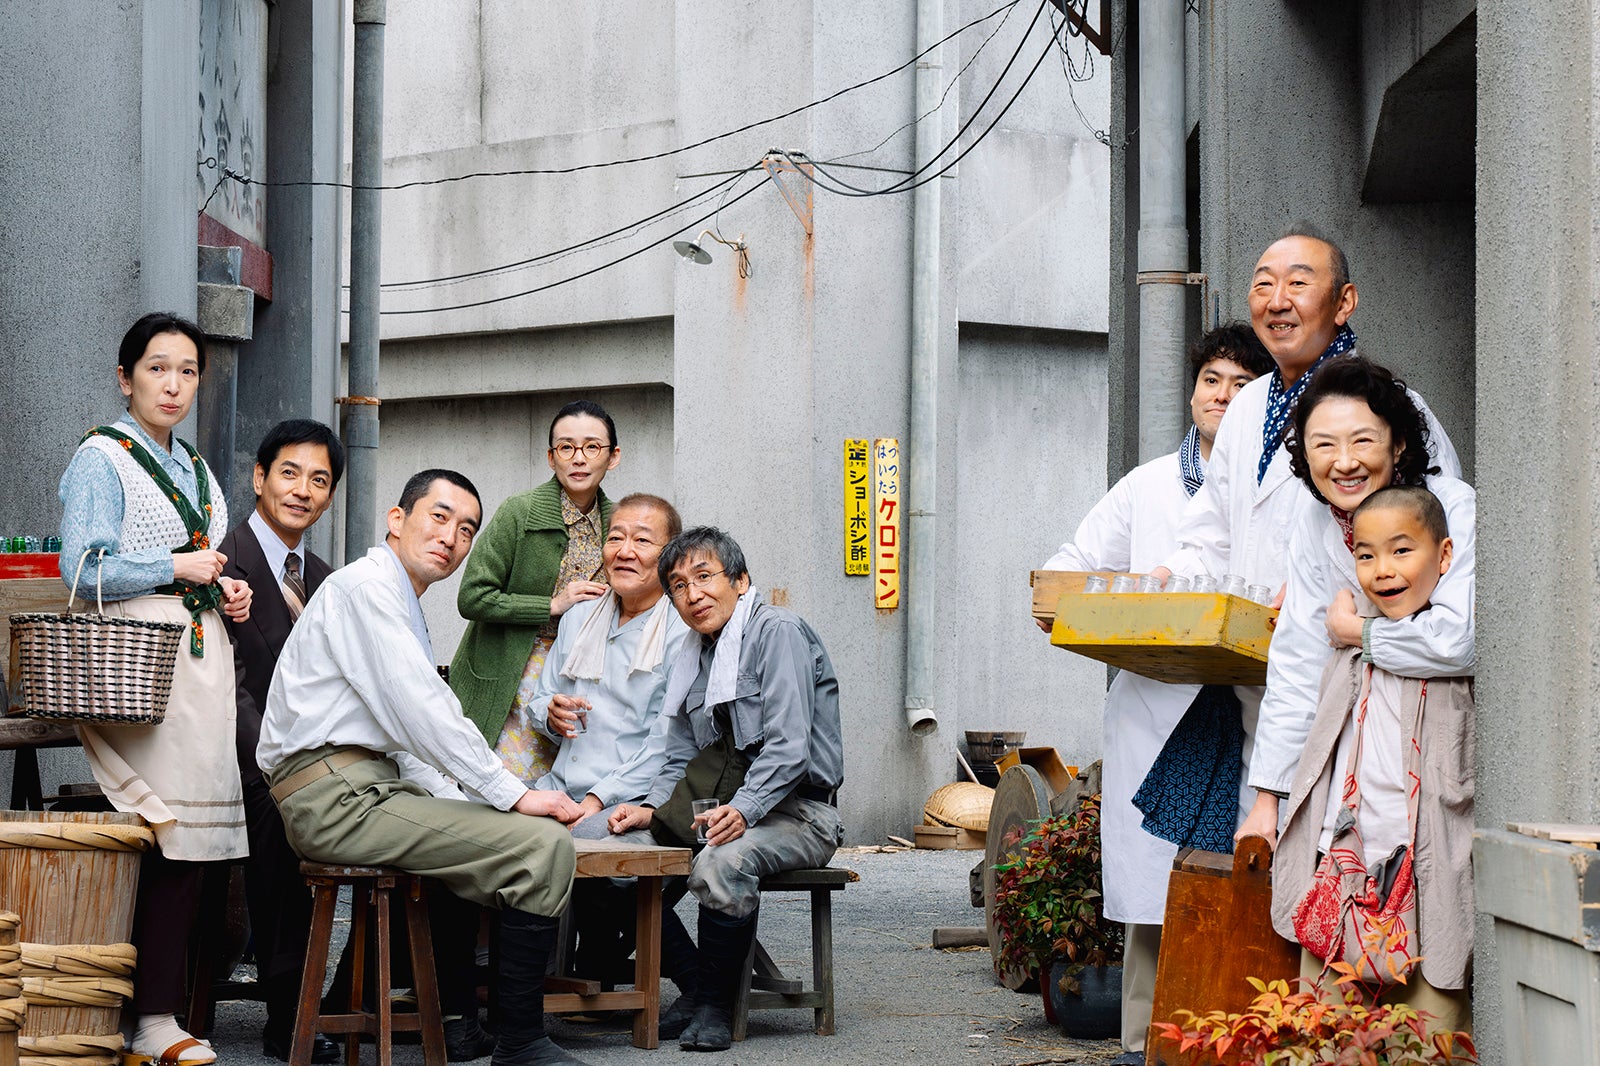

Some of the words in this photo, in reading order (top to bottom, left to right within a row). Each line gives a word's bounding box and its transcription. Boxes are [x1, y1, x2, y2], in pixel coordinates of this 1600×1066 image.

[198, 91, 254, 224] 食堂
[879, 498, 897, 601] ケロニン
